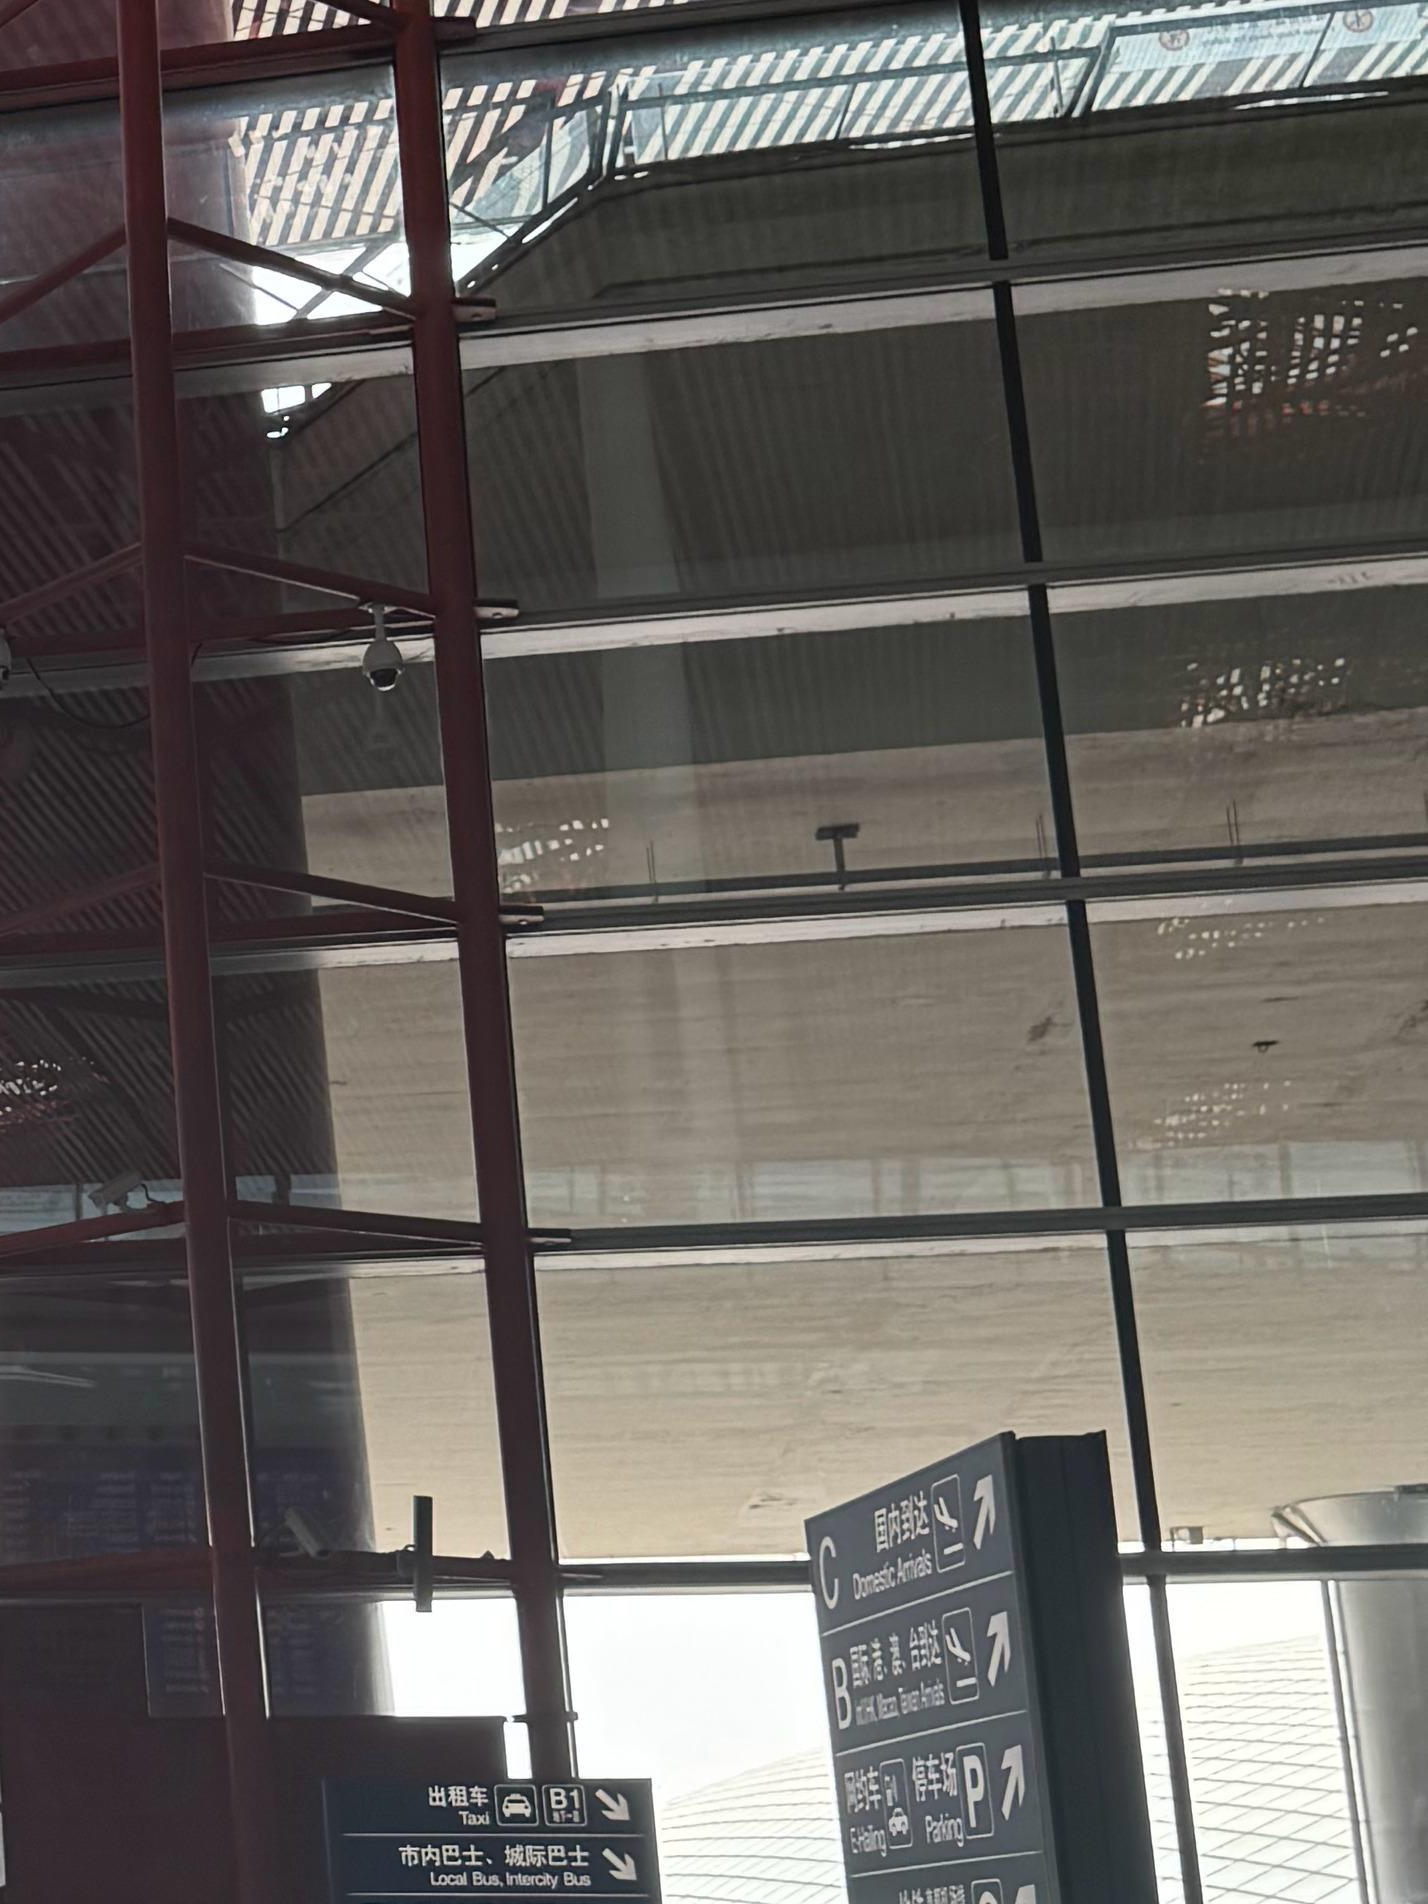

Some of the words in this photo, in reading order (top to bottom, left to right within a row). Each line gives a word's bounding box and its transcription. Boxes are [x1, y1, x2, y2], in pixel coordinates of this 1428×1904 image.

[874, 1490, 931, 1553] 国内到达
[819, 1536, 839, 1610] C
[853, 1558, 895, 1601] Domestic
[896, 1549, 933, 1586] Arrivals
[831, 1658, 852, 1730] B
[428, 1785, 489, 1807] 出租车
[912, 1752, 958, 1802] 停车场
[459, 1811, 490, 1826] Taxi
[549, 1788, 580, 1809] B1
[925, 1813, 964, 1847] Parking
[430, 1872, 467, 1886] Local
[473, 1872, 503, 1887] Bus,
[506, 1872, 558, 1889] Intercity
[564, 1872, 591, 1886] Bus
